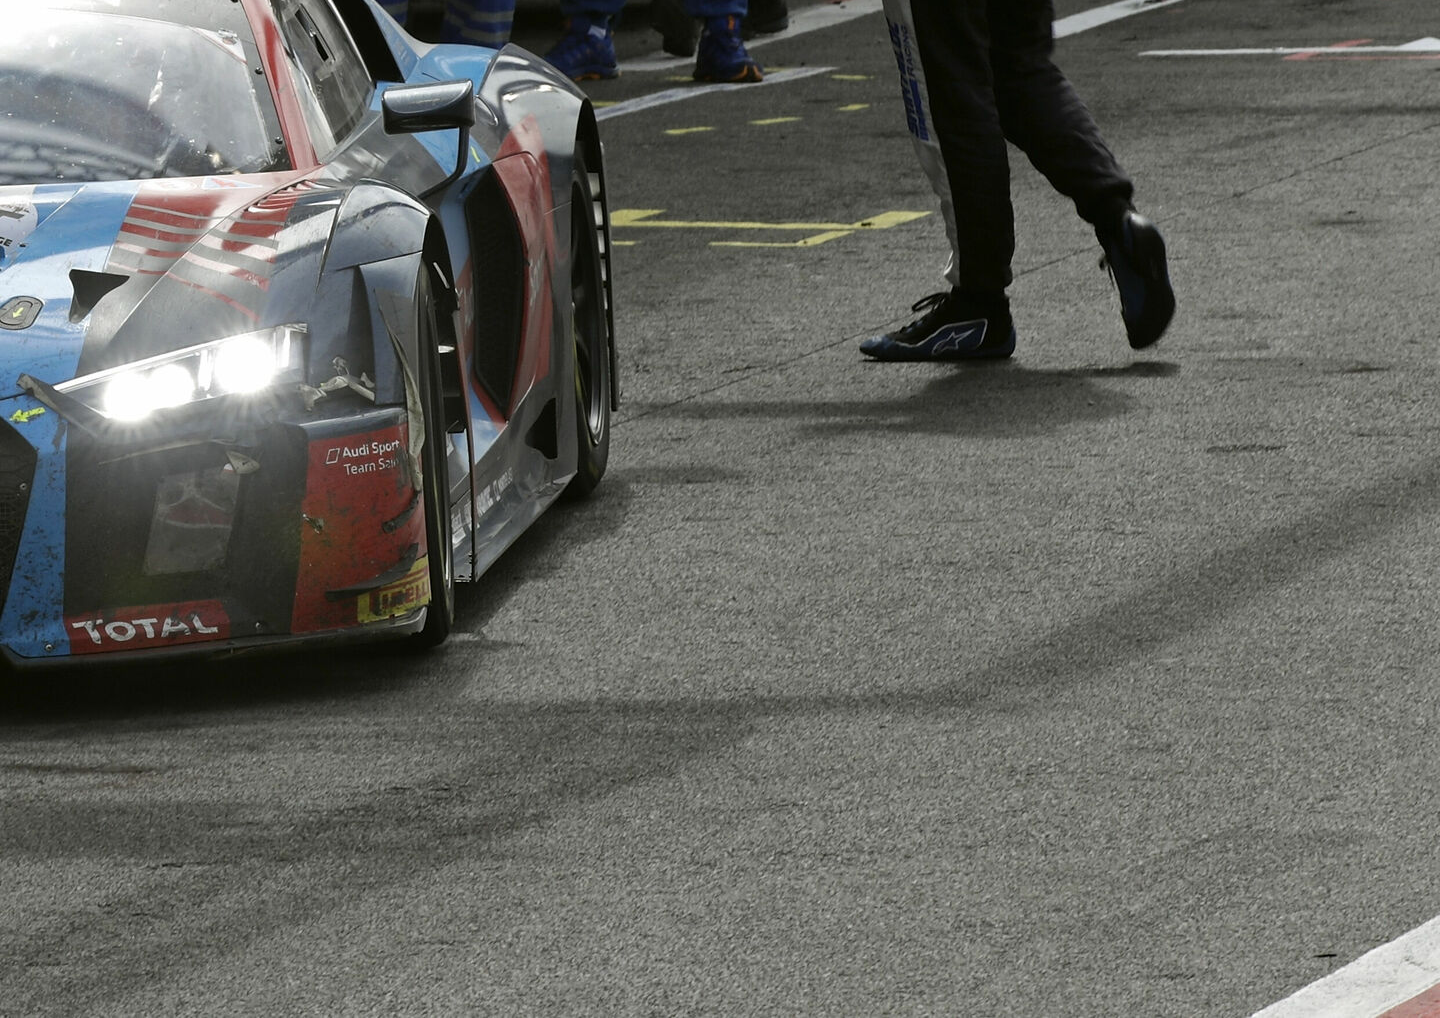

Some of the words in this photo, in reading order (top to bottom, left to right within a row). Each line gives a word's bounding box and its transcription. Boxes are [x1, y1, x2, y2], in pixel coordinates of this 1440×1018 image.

[342, 445, 370, 459] Audi
[372, 439, 401, 456] Sport
[344, 461, 377, 477] Team
[71, 612, 219, 645] TOTAL
